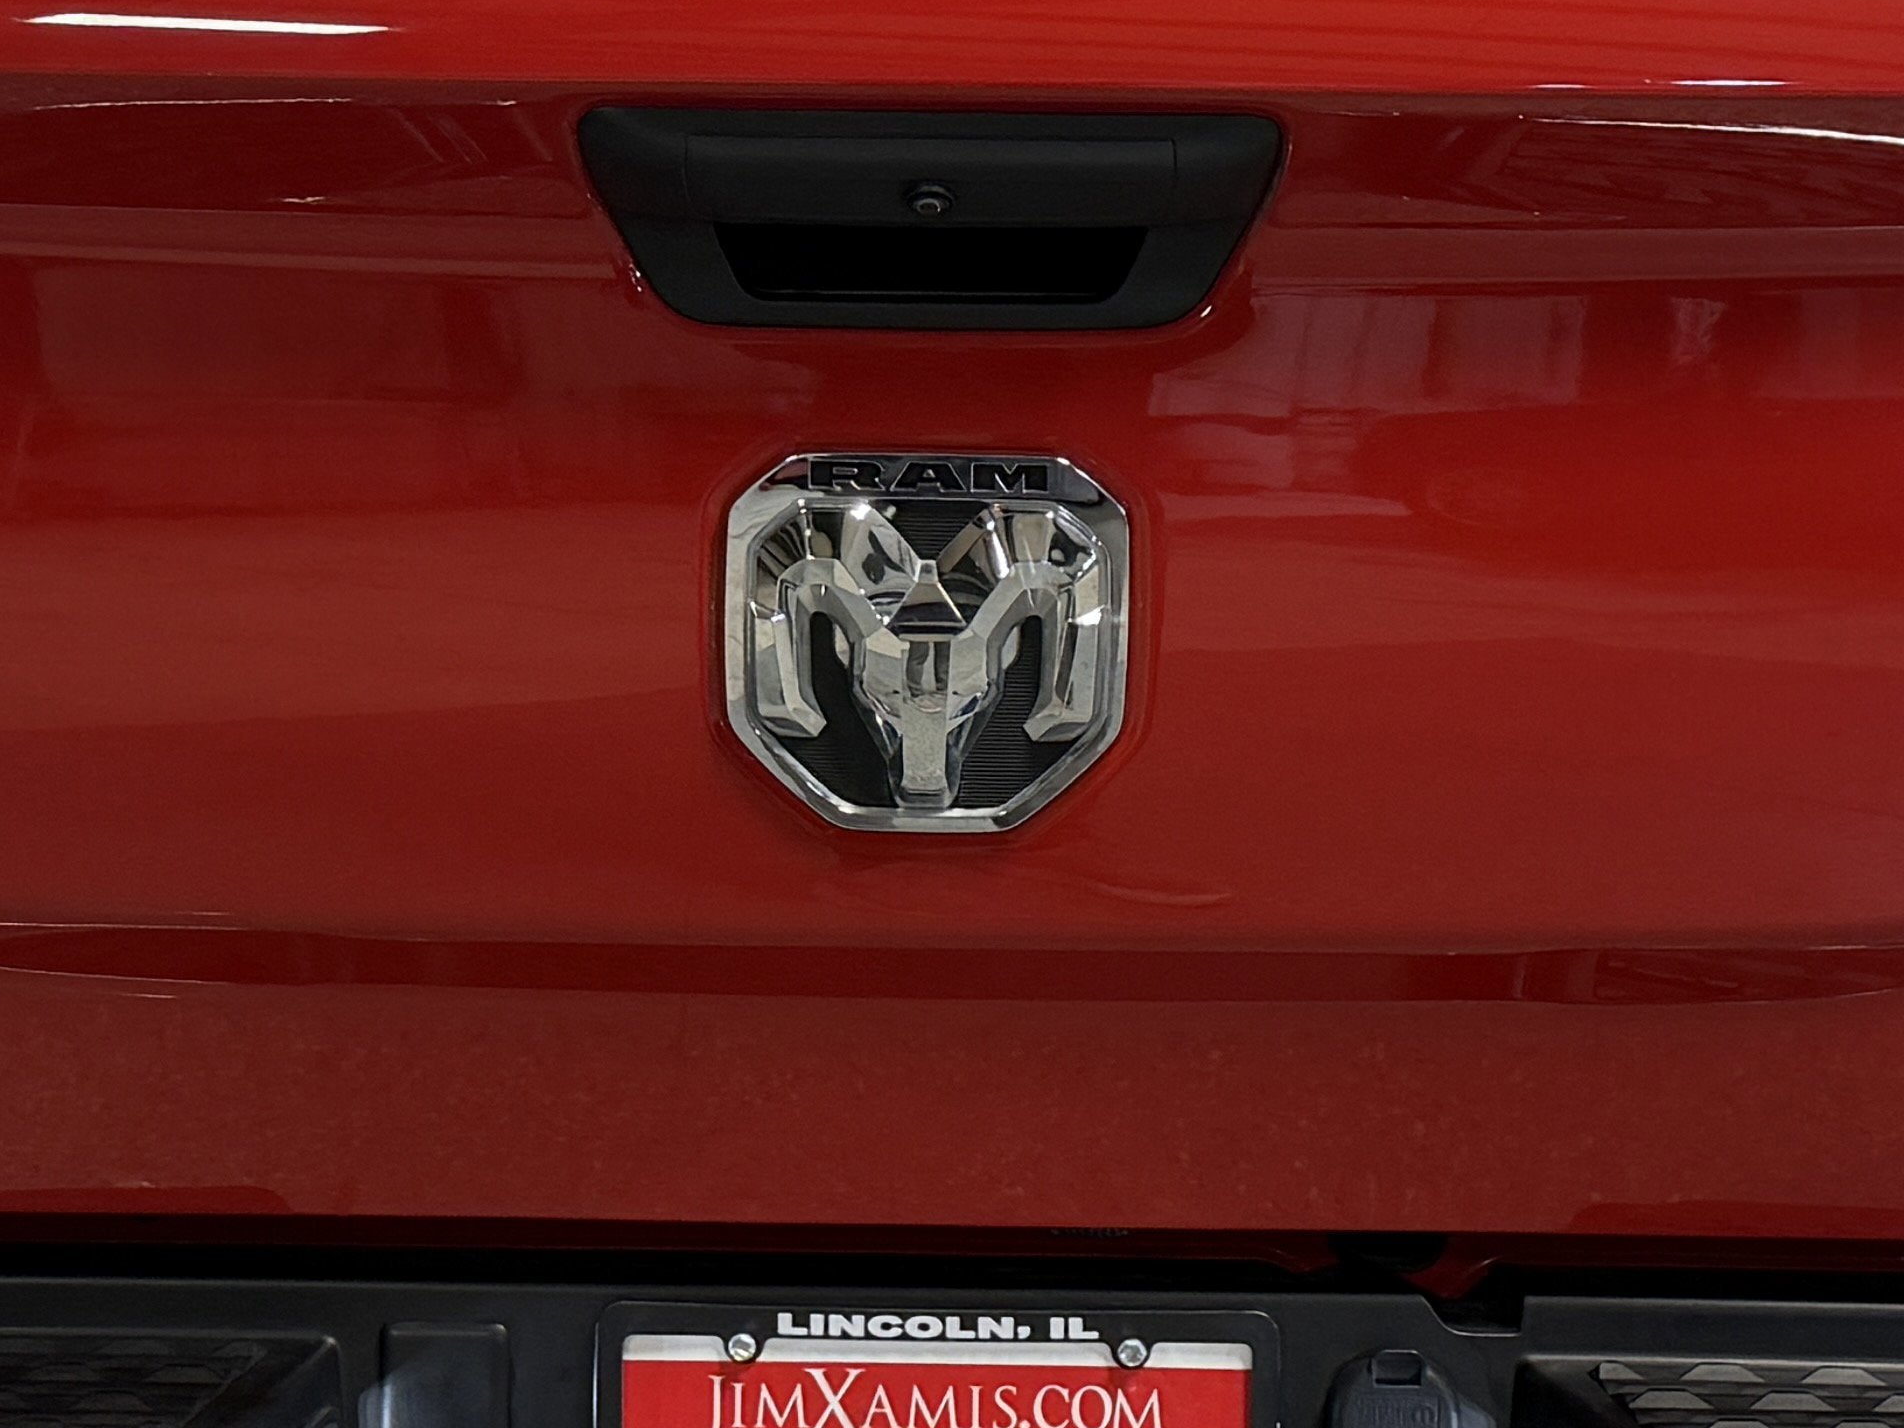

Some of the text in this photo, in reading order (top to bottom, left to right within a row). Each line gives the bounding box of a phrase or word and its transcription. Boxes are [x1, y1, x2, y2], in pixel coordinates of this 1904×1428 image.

[807, 459, 1050, 493] RAM
[777, 1313, 1100, 1341] LINCOLN, IL
